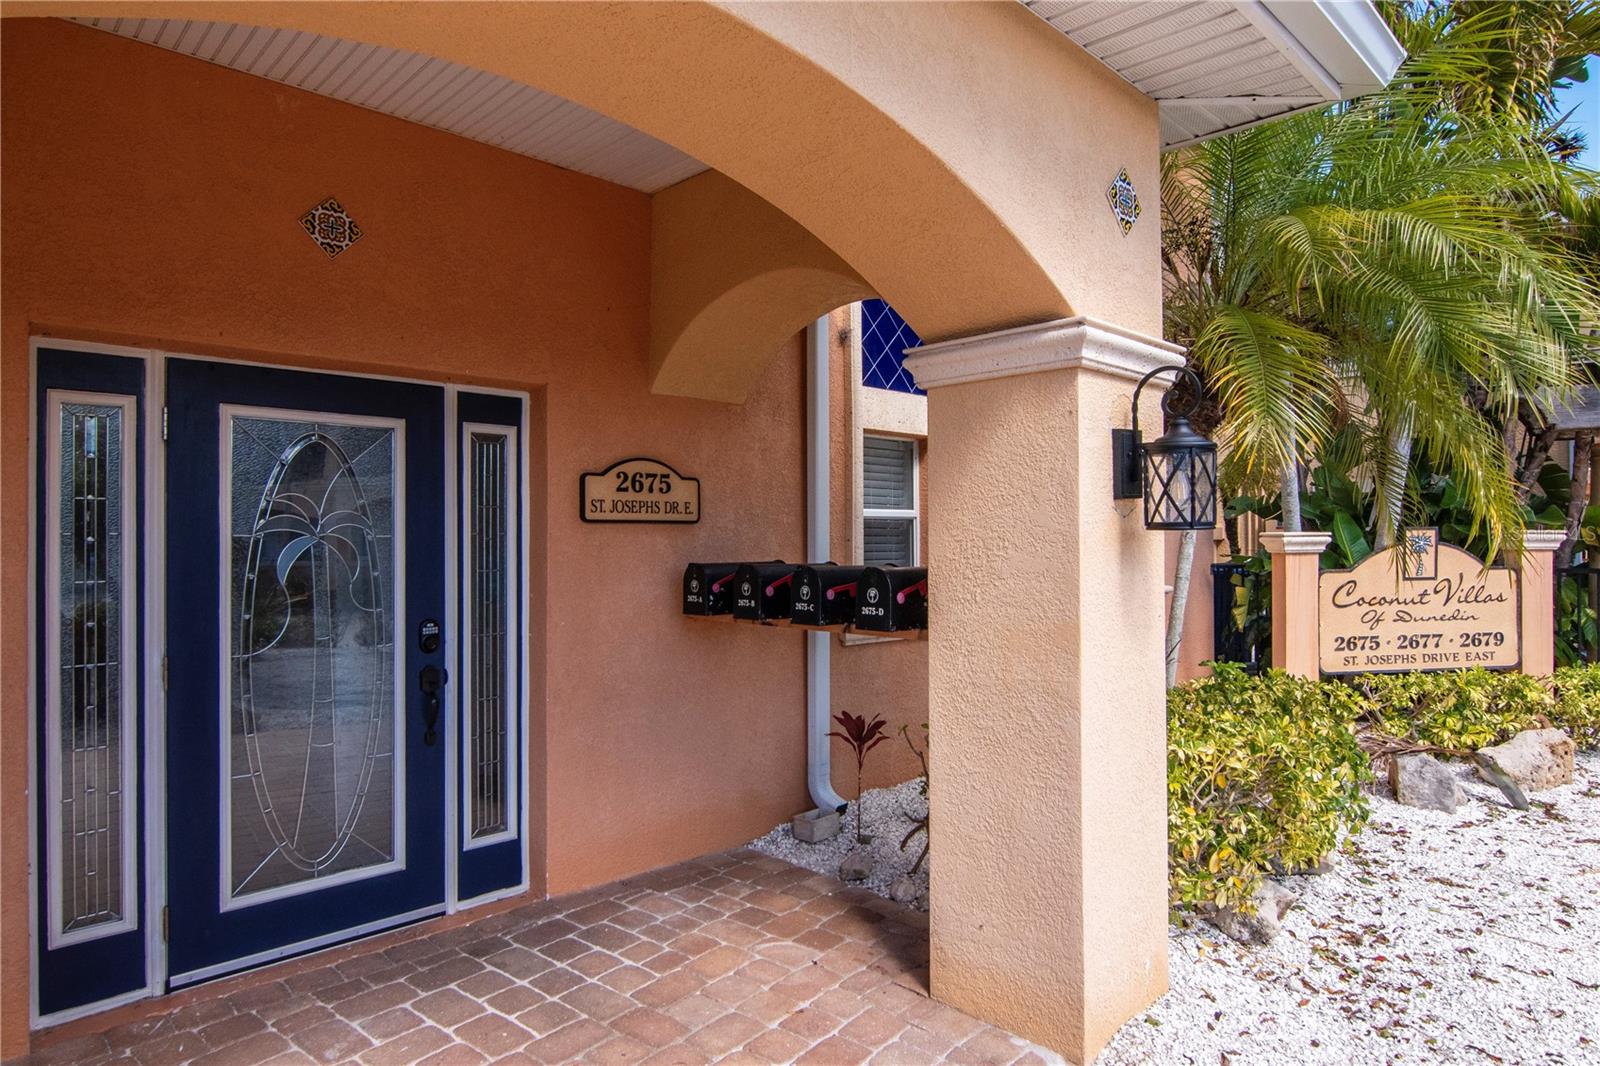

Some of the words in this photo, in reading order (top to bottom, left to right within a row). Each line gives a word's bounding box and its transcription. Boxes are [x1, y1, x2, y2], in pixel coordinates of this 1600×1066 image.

[616, 471, 671, 494] 2675
[590, 499, 606, 513] ST.
[610, 499, 660, 514] JOSEPHS
[664, 501, 682, 514] DR.
[684, 502, 694, 515] E.
[1332, 580, 1430, 608] Coconut
[1433, 572, 1508, 607] Villas
[795, 602, 815, 612] 2675-C
[861, 606, 885, 616] 2675-D
[1360, 609, 1386, 630] Of
[1392, 608, 1481, 624] Dunedin
[1333, 635, 1381, 652] 2675
[1396, 633, 1444, 650] 2677
[1459, 631, 1505, 648] 2679
[1343, 655, 1359, 667] ST.
[1364, 653, 1417, 666] JOSEPHS
[1422, 652, 1460, 663] DRIVE
[1465, 650, 1496, 662] EAST
